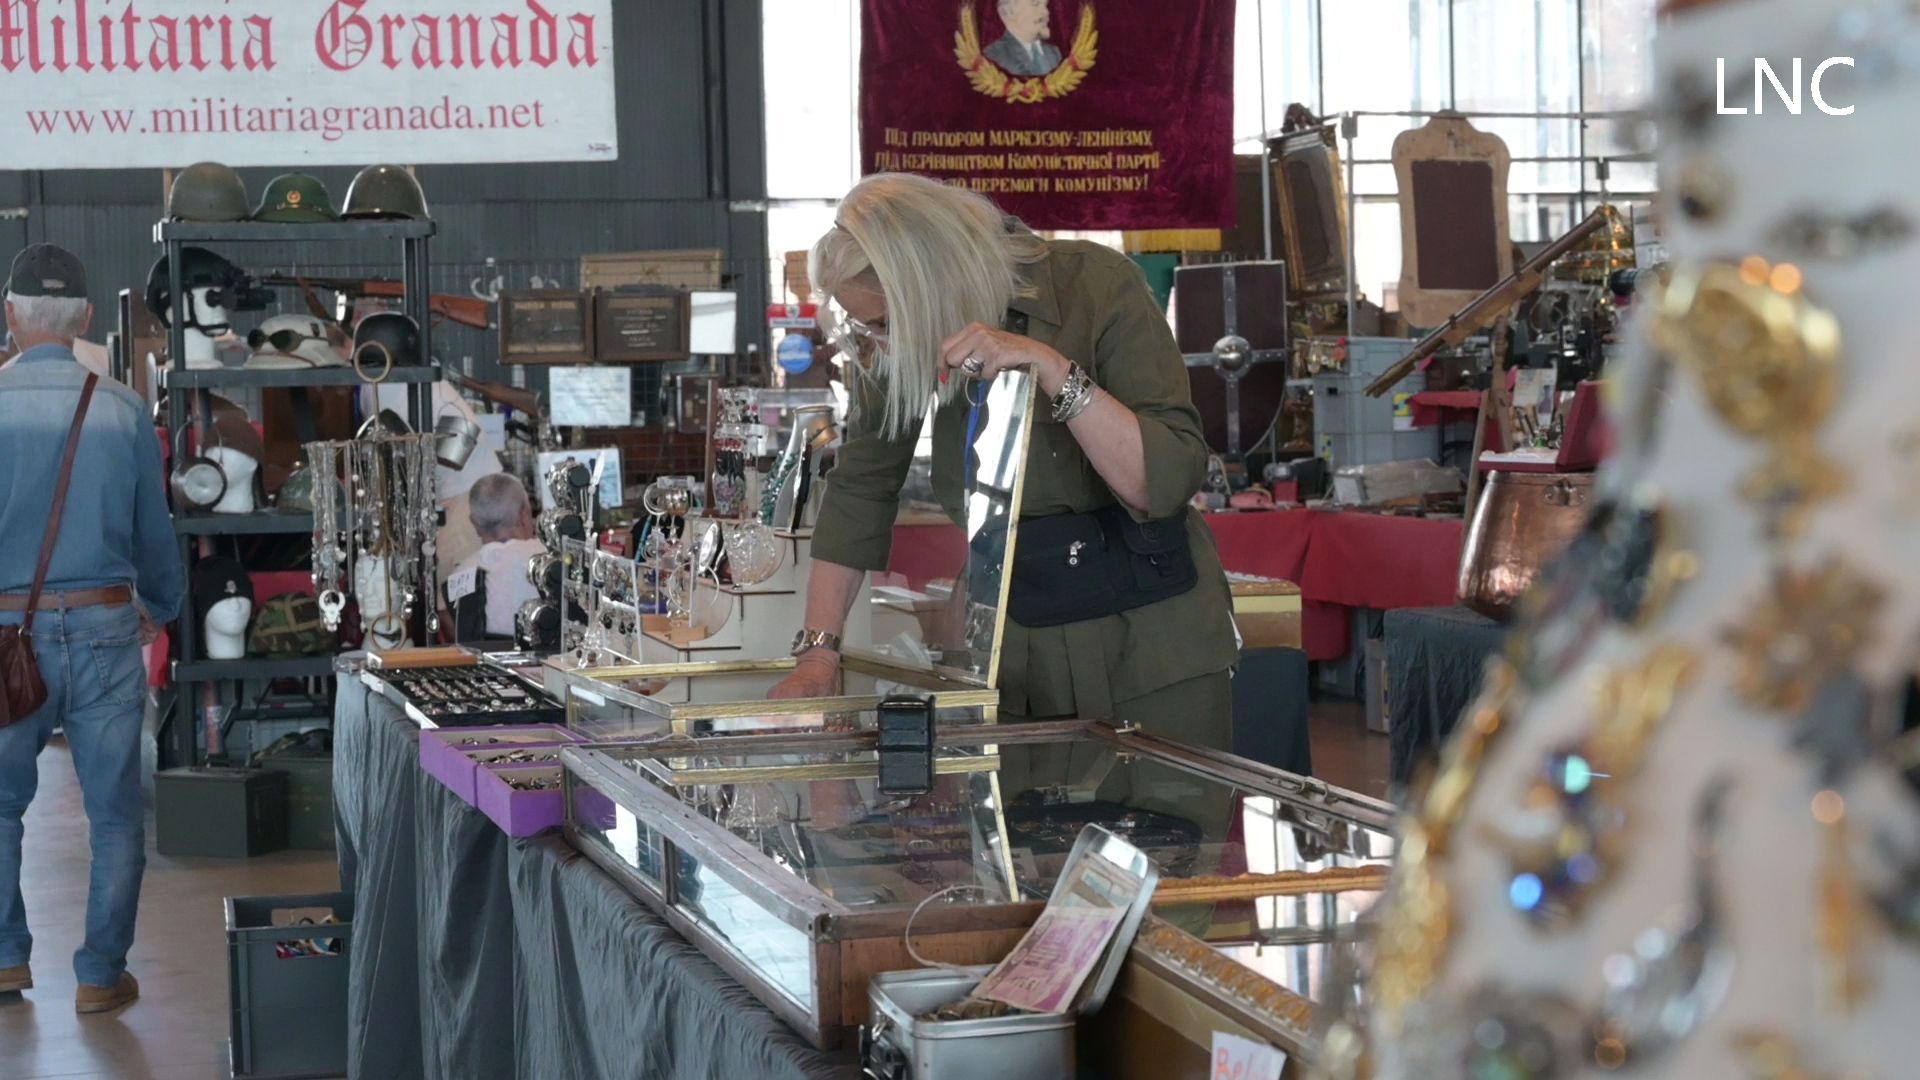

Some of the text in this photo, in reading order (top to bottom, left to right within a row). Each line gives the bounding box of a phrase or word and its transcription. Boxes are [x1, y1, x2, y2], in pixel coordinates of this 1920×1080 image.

[0, 0, 600, 73] Militaria Granada
[26, 95, 546, 141] www.militariagranada.net
